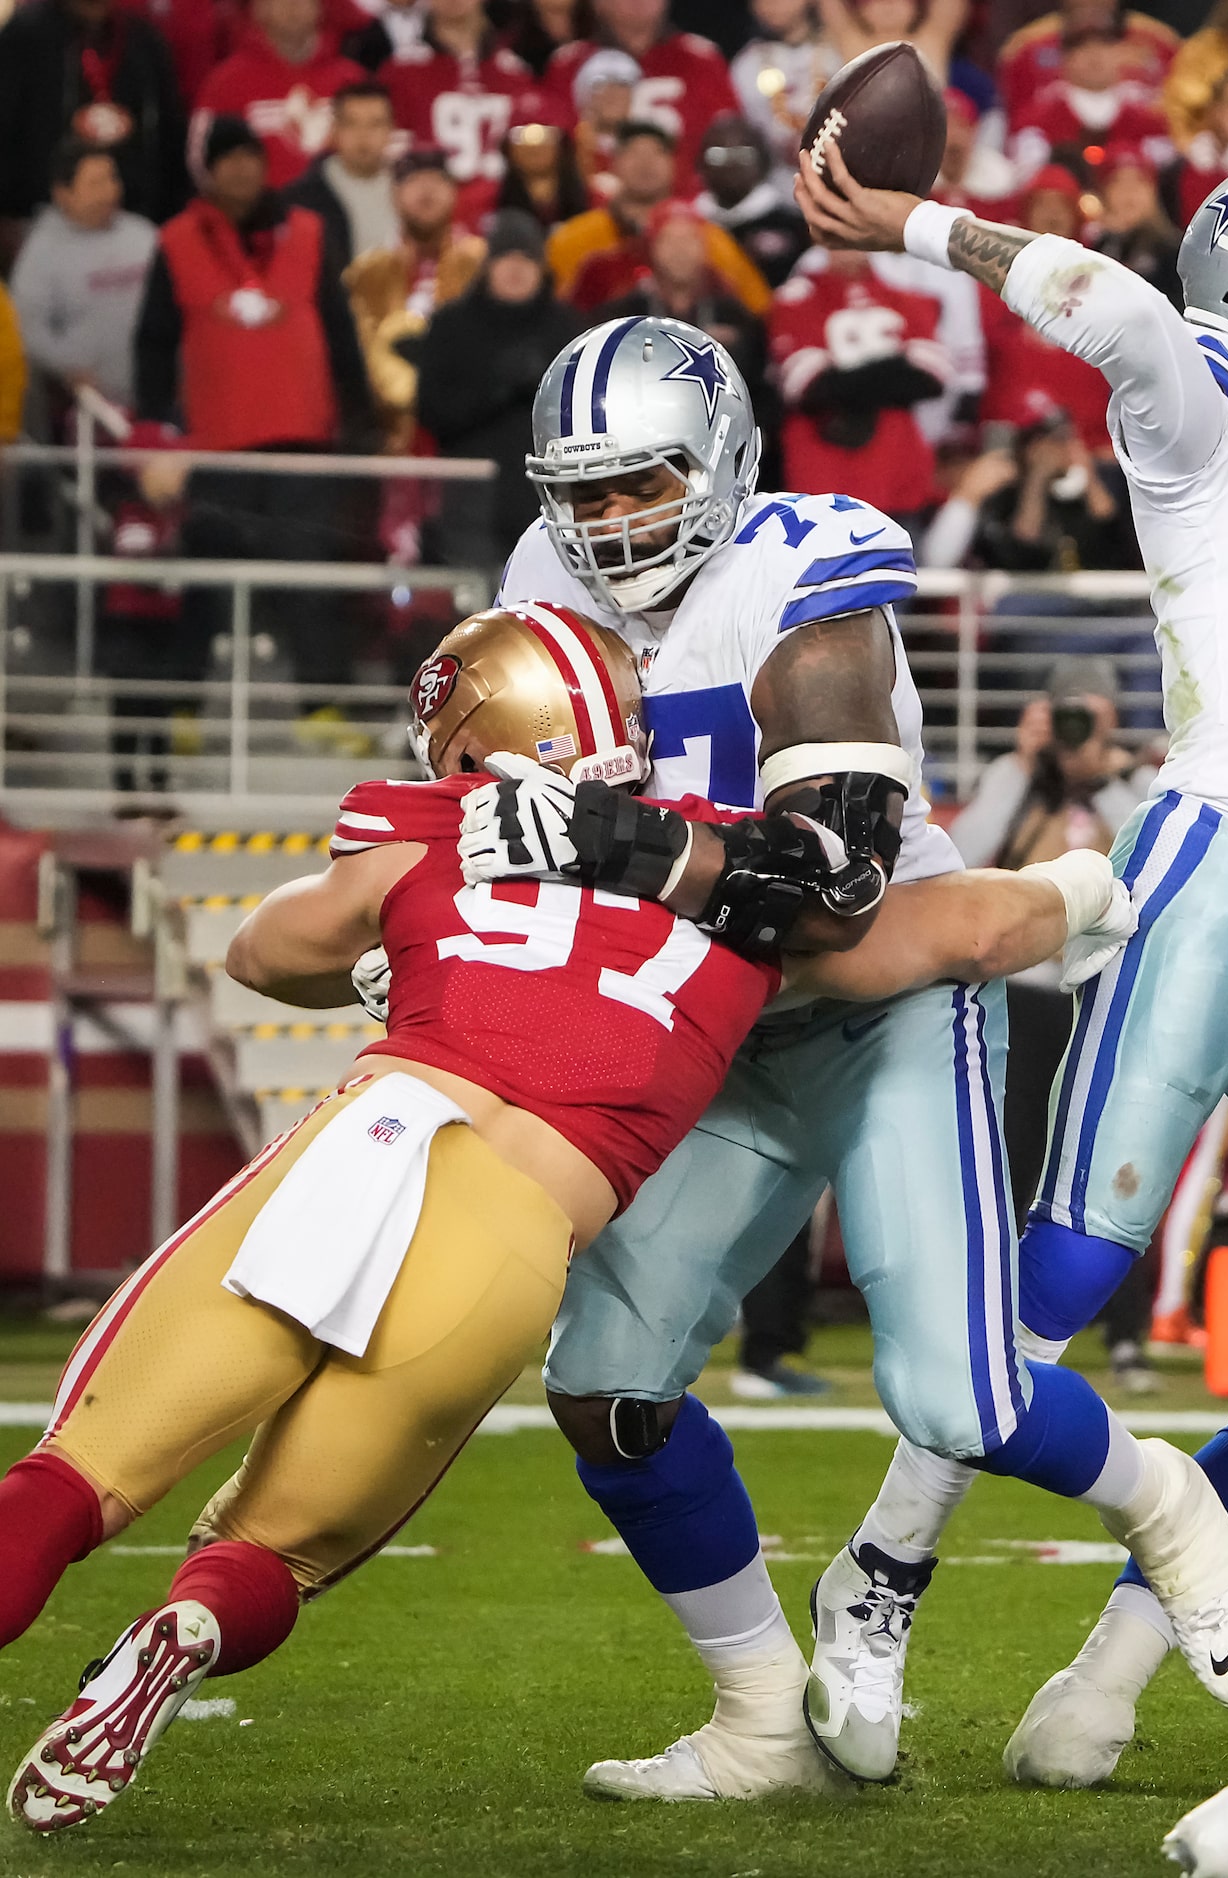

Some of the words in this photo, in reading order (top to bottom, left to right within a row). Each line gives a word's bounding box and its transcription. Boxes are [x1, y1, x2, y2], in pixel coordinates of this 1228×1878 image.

[563, 442, 602, 454] COWBOYS
[580, 753, 636, 781] 49ERS
[435, 878, 713, 1033] 97
[370, 1124, 395, 1143] NFL
